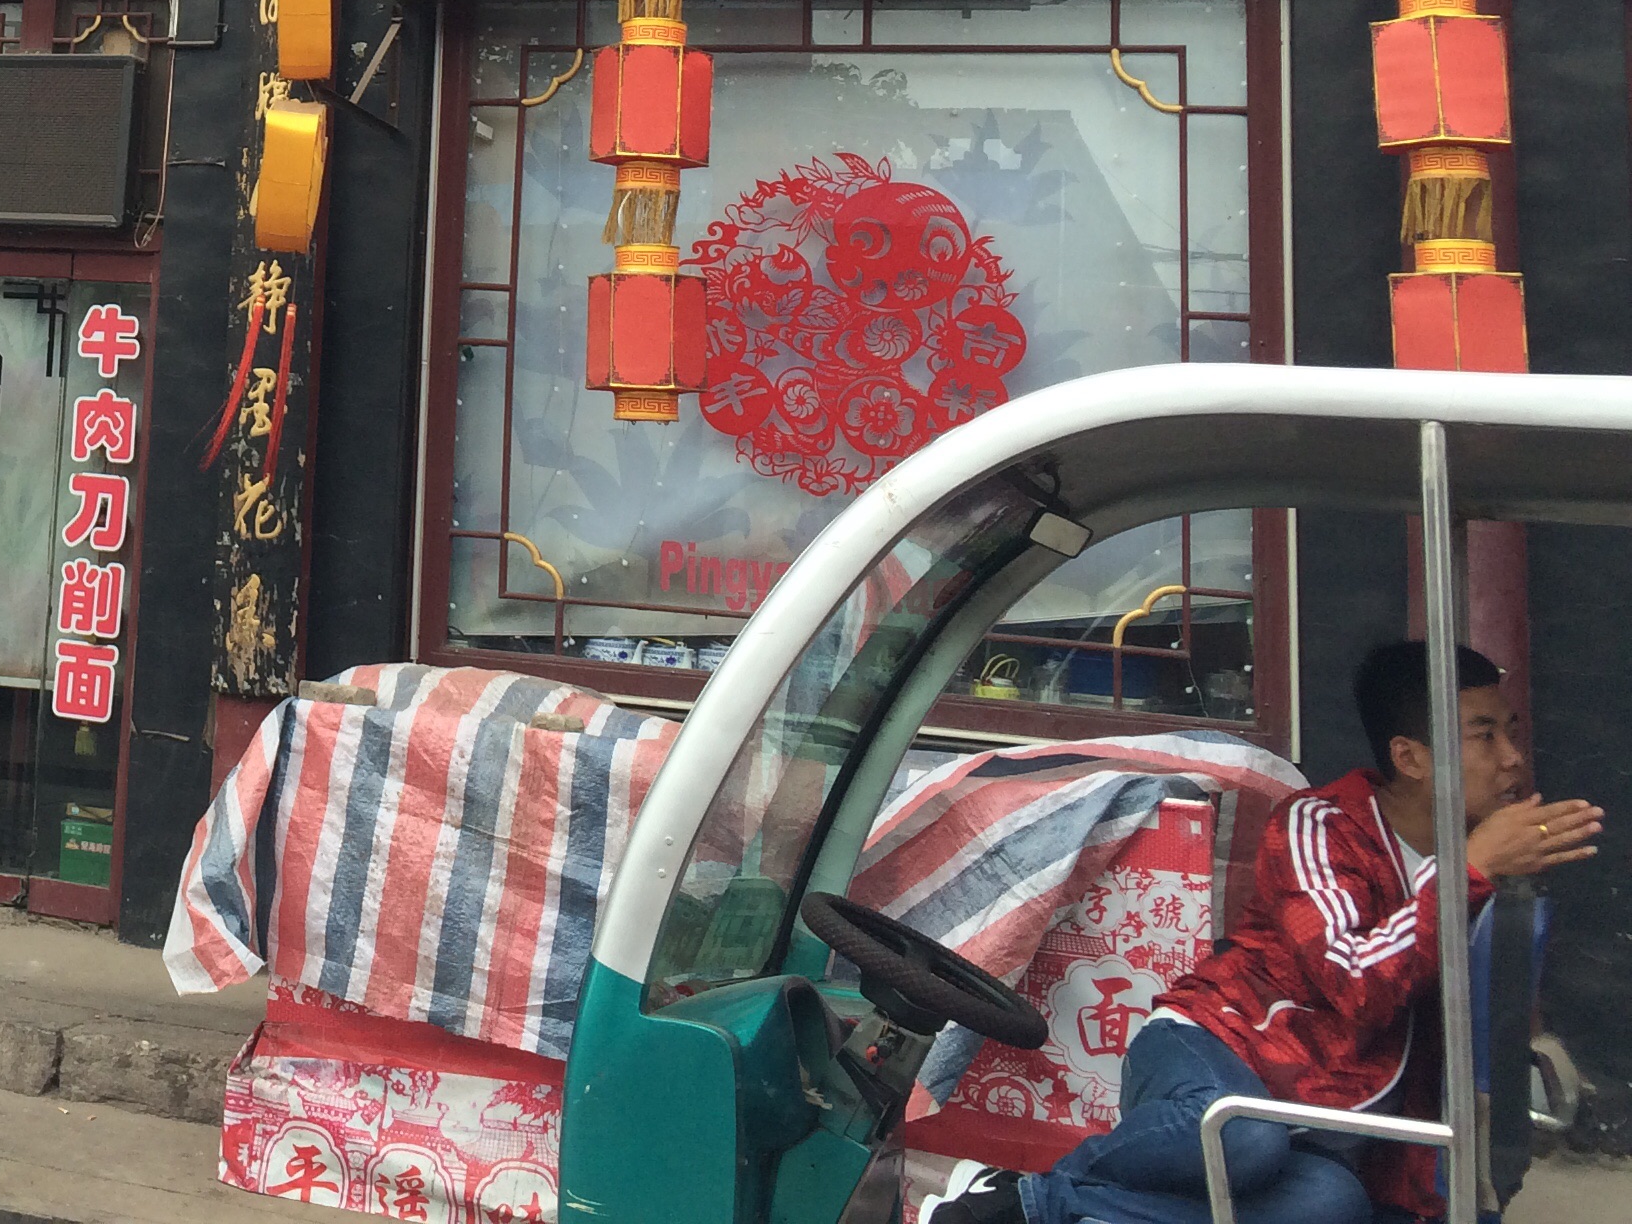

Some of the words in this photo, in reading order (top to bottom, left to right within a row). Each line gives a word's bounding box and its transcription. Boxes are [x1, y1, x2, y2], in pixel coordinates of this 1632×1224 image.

[51, 304, 139, 723] 牛肉刀削面
[660, 540, 792, 611] Pingy
[1078, 977, 1152, 1057] 面
